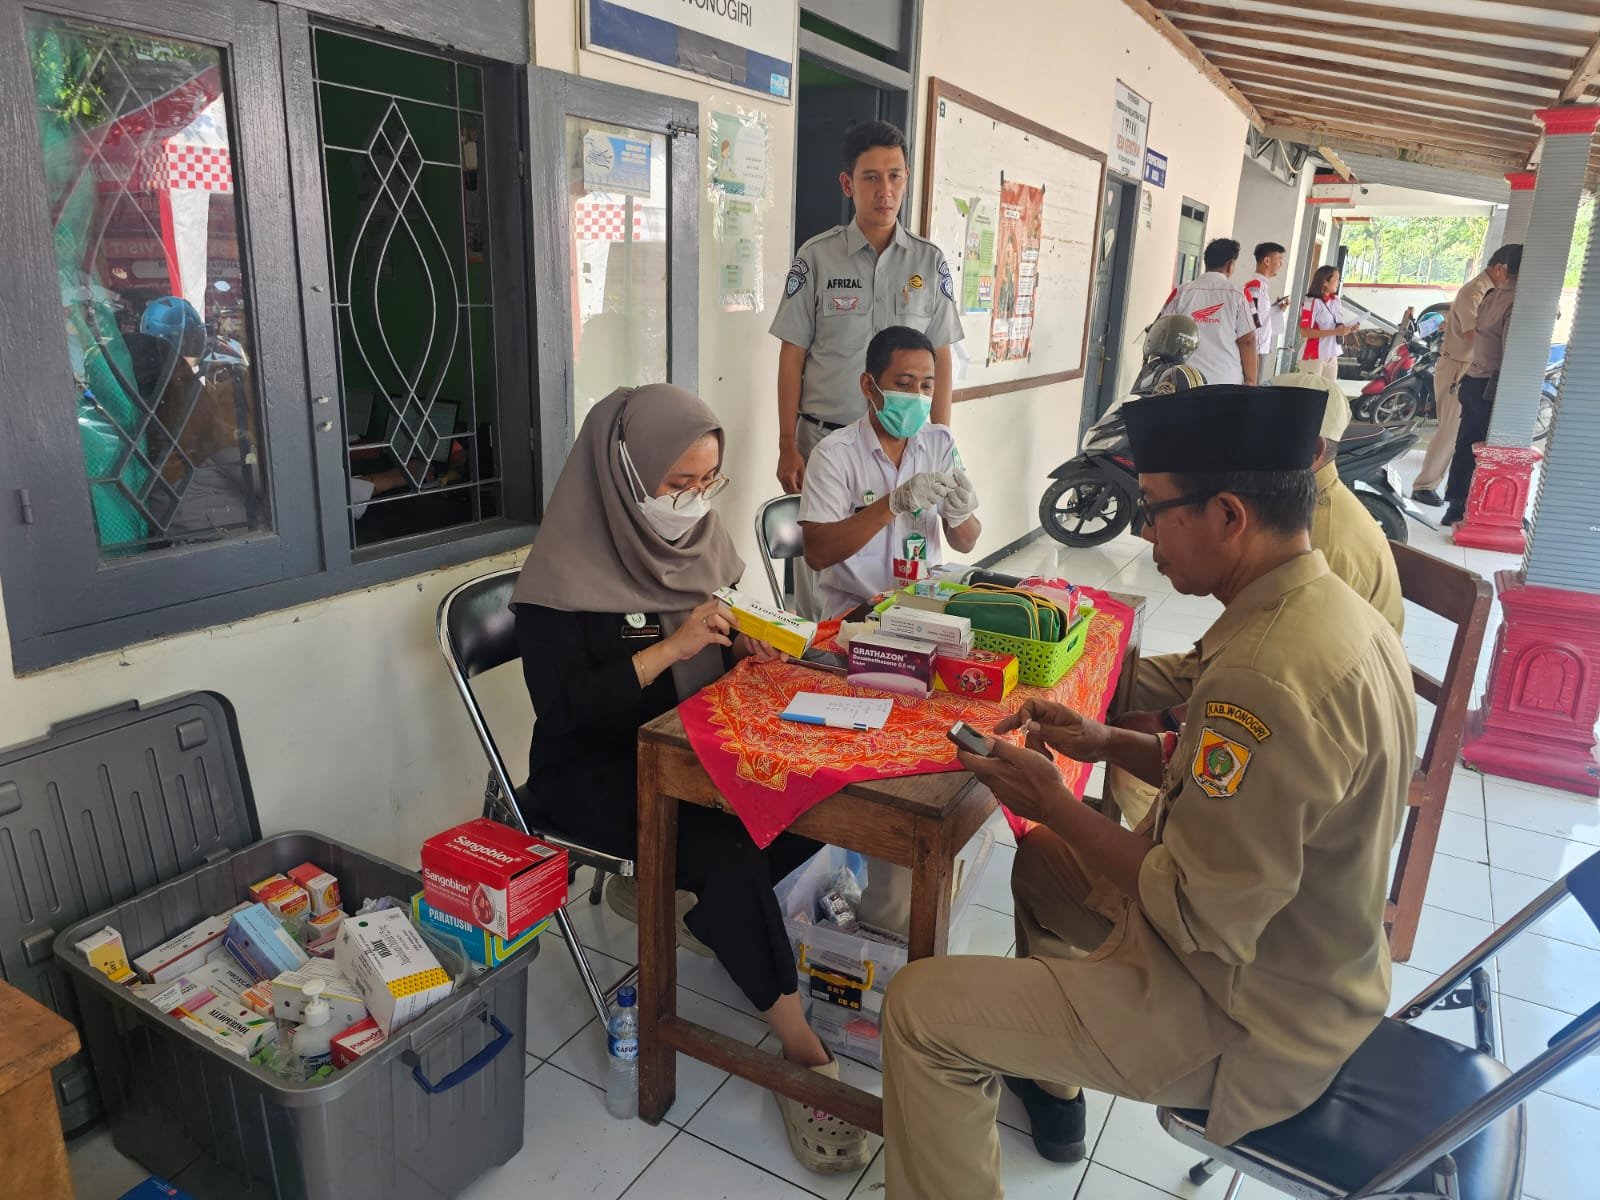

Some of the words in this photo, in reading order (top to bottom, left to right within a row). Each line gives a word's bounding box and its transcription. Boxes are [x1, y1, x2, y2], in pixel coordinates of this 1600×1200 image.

[680, 0, 752, 27] NOGIRI
[827, 278, 862, 290] AFRIZAL
[853, 647, 904, 662] GRATHAZON
[453, 835, 514, 864] Sangobion
[424, 867, 469, 894] Sangobion
[429, 907, 473, 933] PARATUSIN
[207, 1009, 251, 1035] ALLOPURINOL
